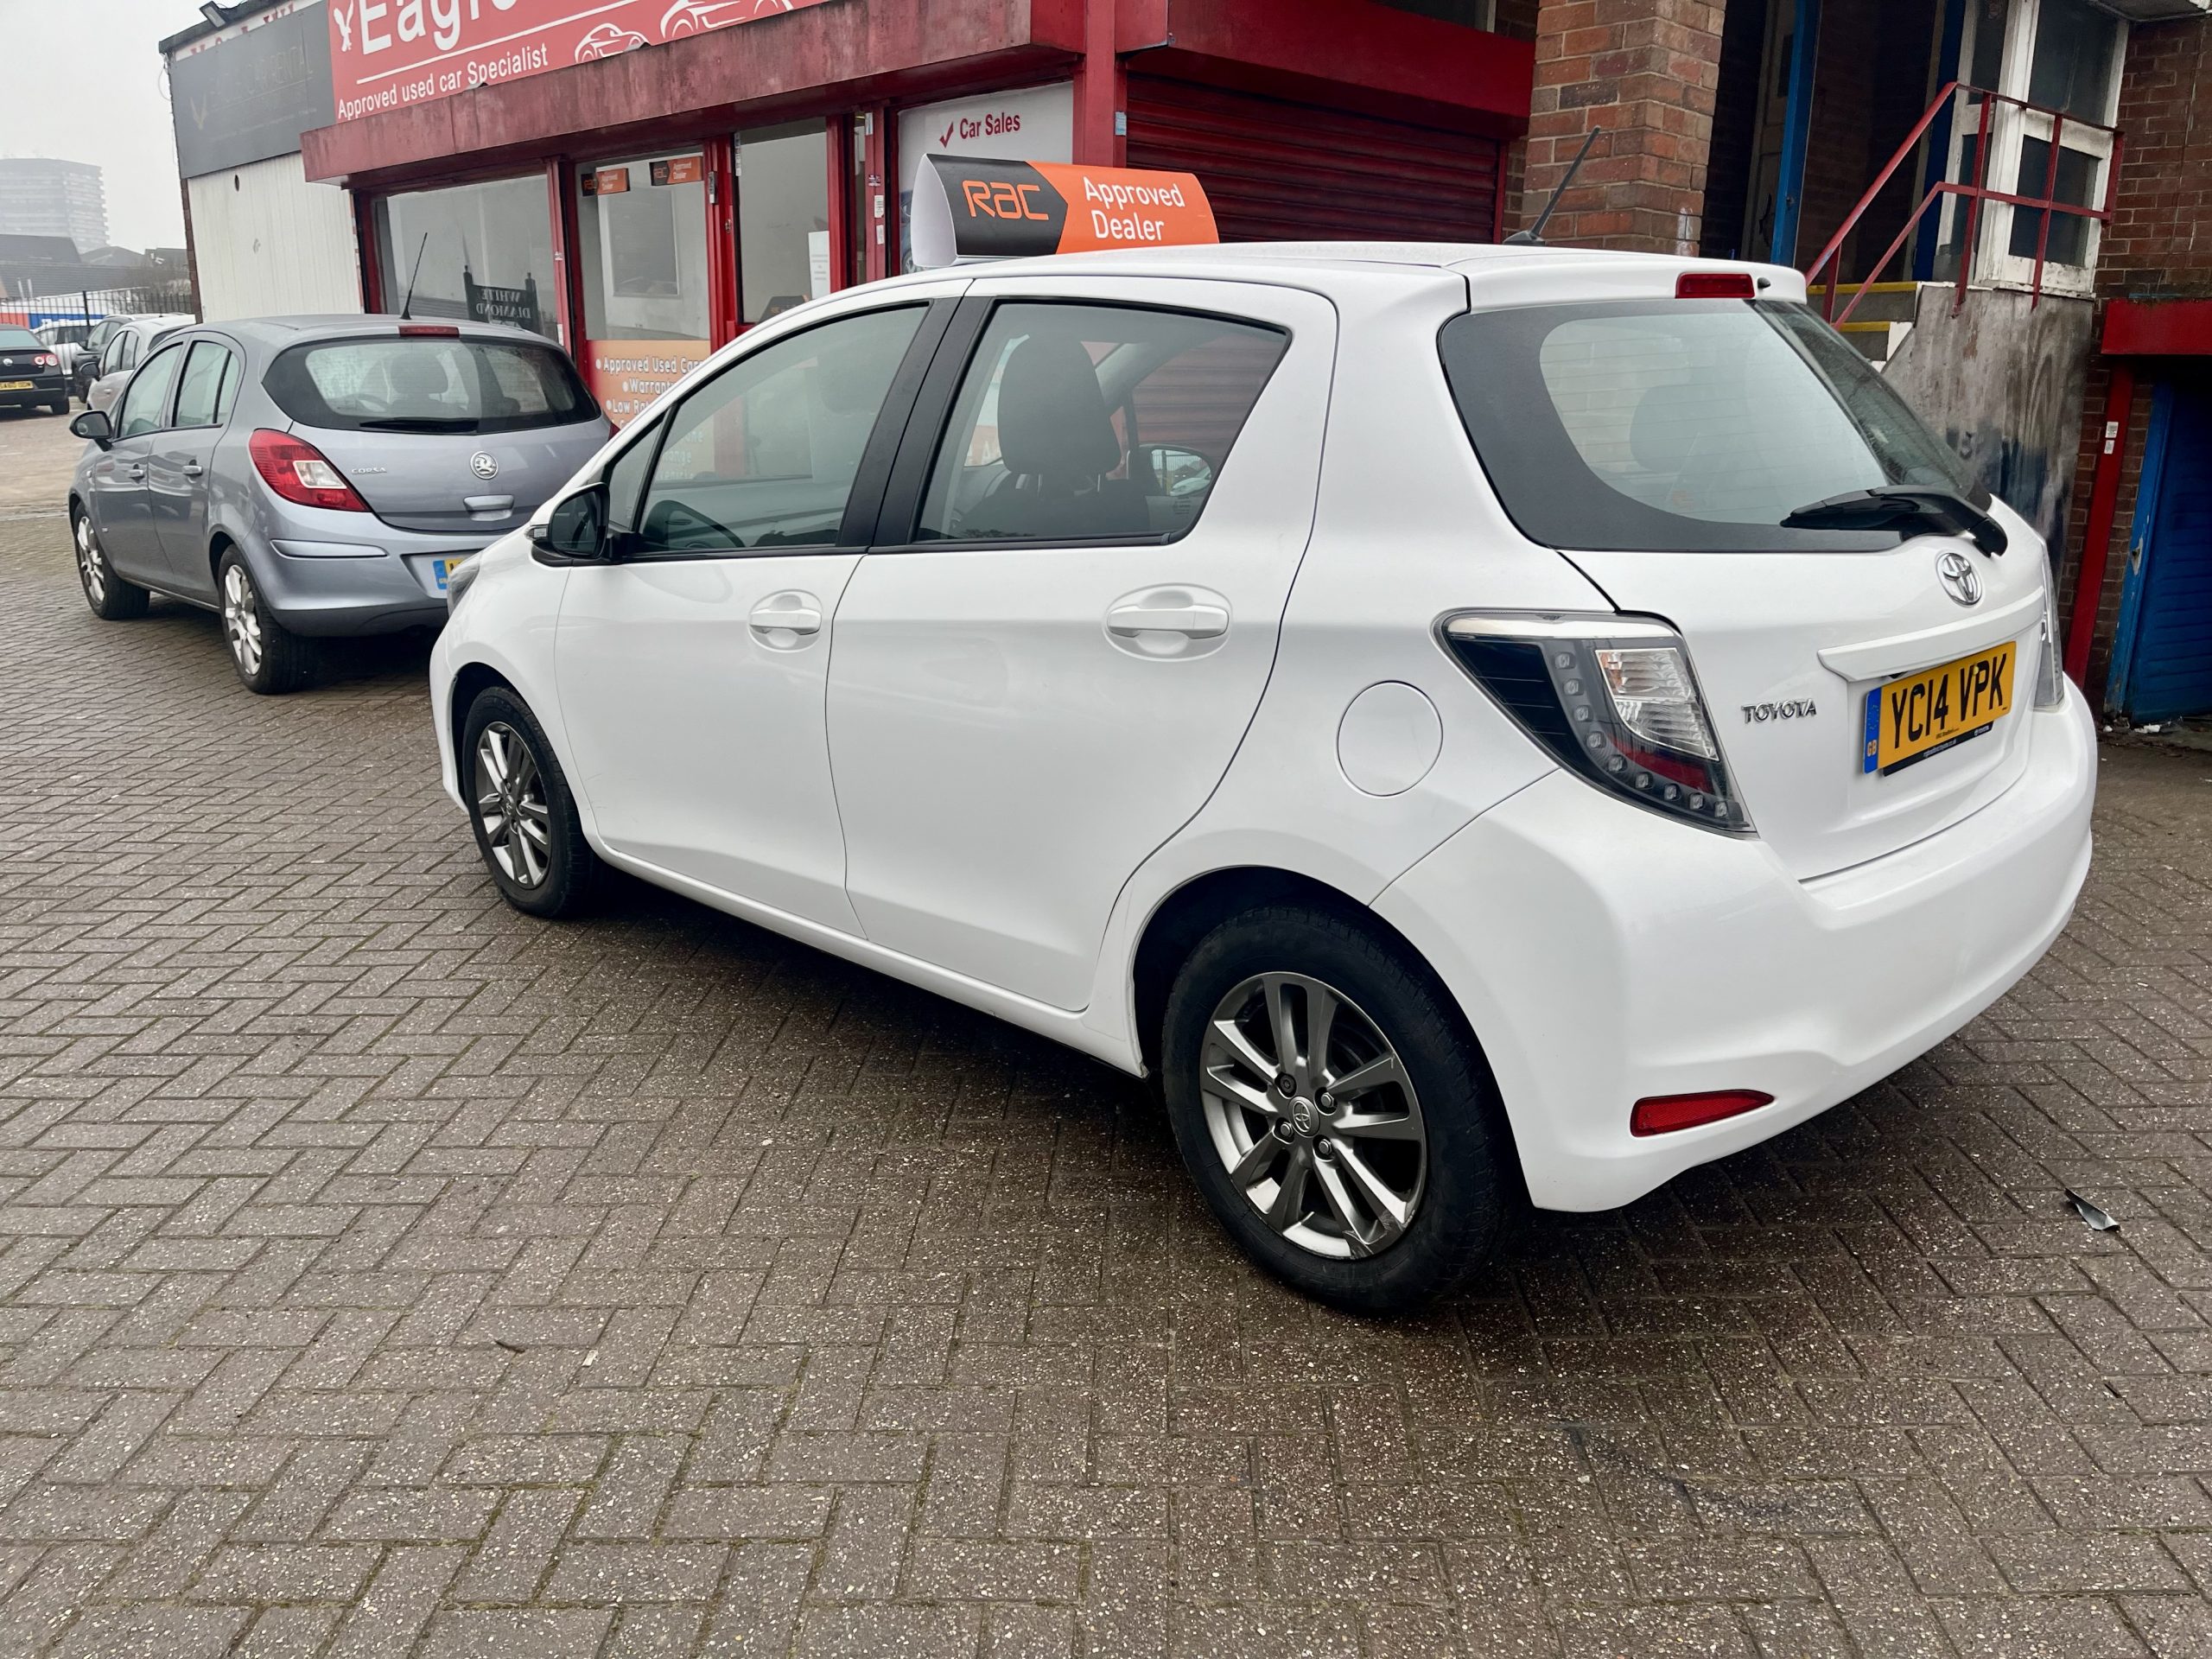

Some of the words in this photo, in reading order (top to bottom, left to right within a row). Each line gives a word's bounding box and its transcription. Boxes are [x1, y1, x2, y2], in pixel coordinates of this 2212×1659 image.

[359, 0, 517, 54] Eag
[338, 84, 397, 120] Approved
[402, 73, 435, 102] used
[439, 71, 461, 92] car
[467, 42, 549, 86] Specialist
[960, 117, 982, 139] Car
[986, 111, 1020, 136] Sales
[962, 180, 1049, 220] RAC
[1084, 176, 1185, 209] Approved
[1091, 210, 1165, 241] Dealer
[603, 357, 649, 375] Approved
[652, 356, 677, 373] Used
[613, 398, 630, 414] Low
[1741, 698, 1816, 723] TOYOTA
[1891, 674, 1949, 749] YC14
[1960, 653, 2007, 722] VPK
[1866, 740, 1878, 757] GB
